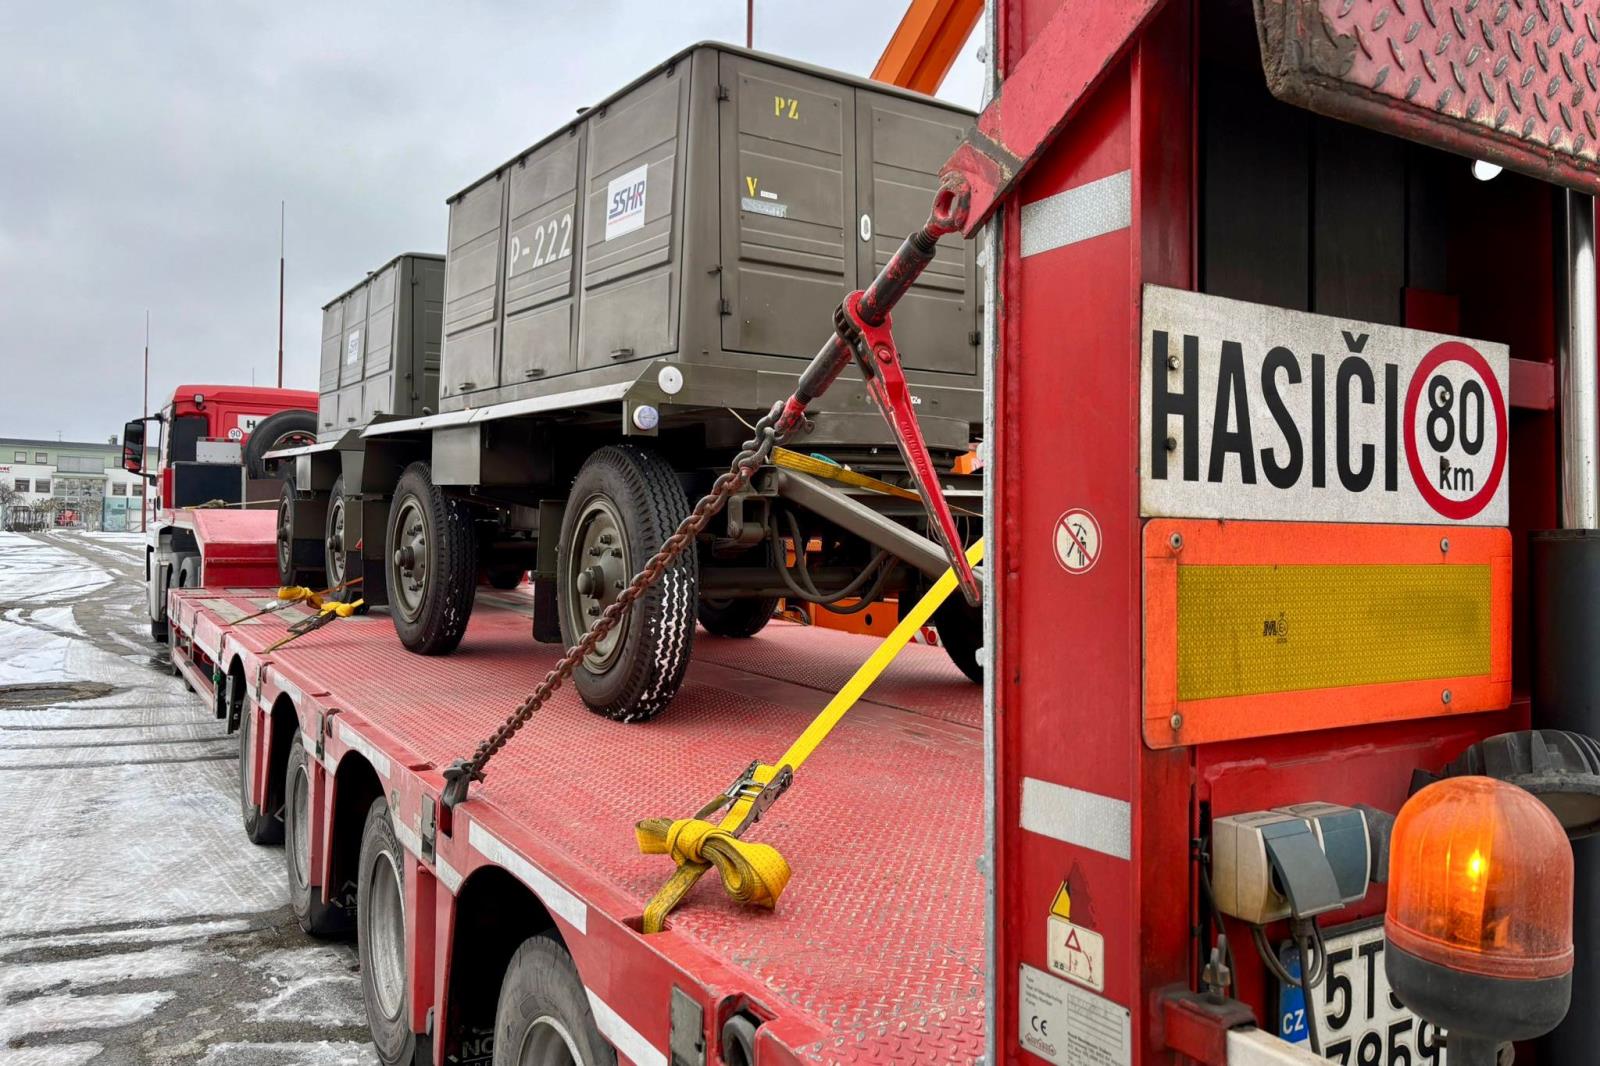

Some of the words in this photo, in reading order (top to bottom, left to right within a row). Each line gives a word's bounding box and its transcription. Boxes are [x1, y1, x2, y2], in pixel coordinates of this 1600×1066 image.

[775, 96, 799, 120] PZ
[609, 180, 645, 219] SSHR
[509, 213, 572, 278] P-222
[1151, 330, 1399, 493] HASIČI
[1426, 374, 1485, 456] 80
[1439, 455, 1474, 492] km
[1326, 939, 1406, 1030] 5T
[1282, 1008, 1305, 1035] CZ
